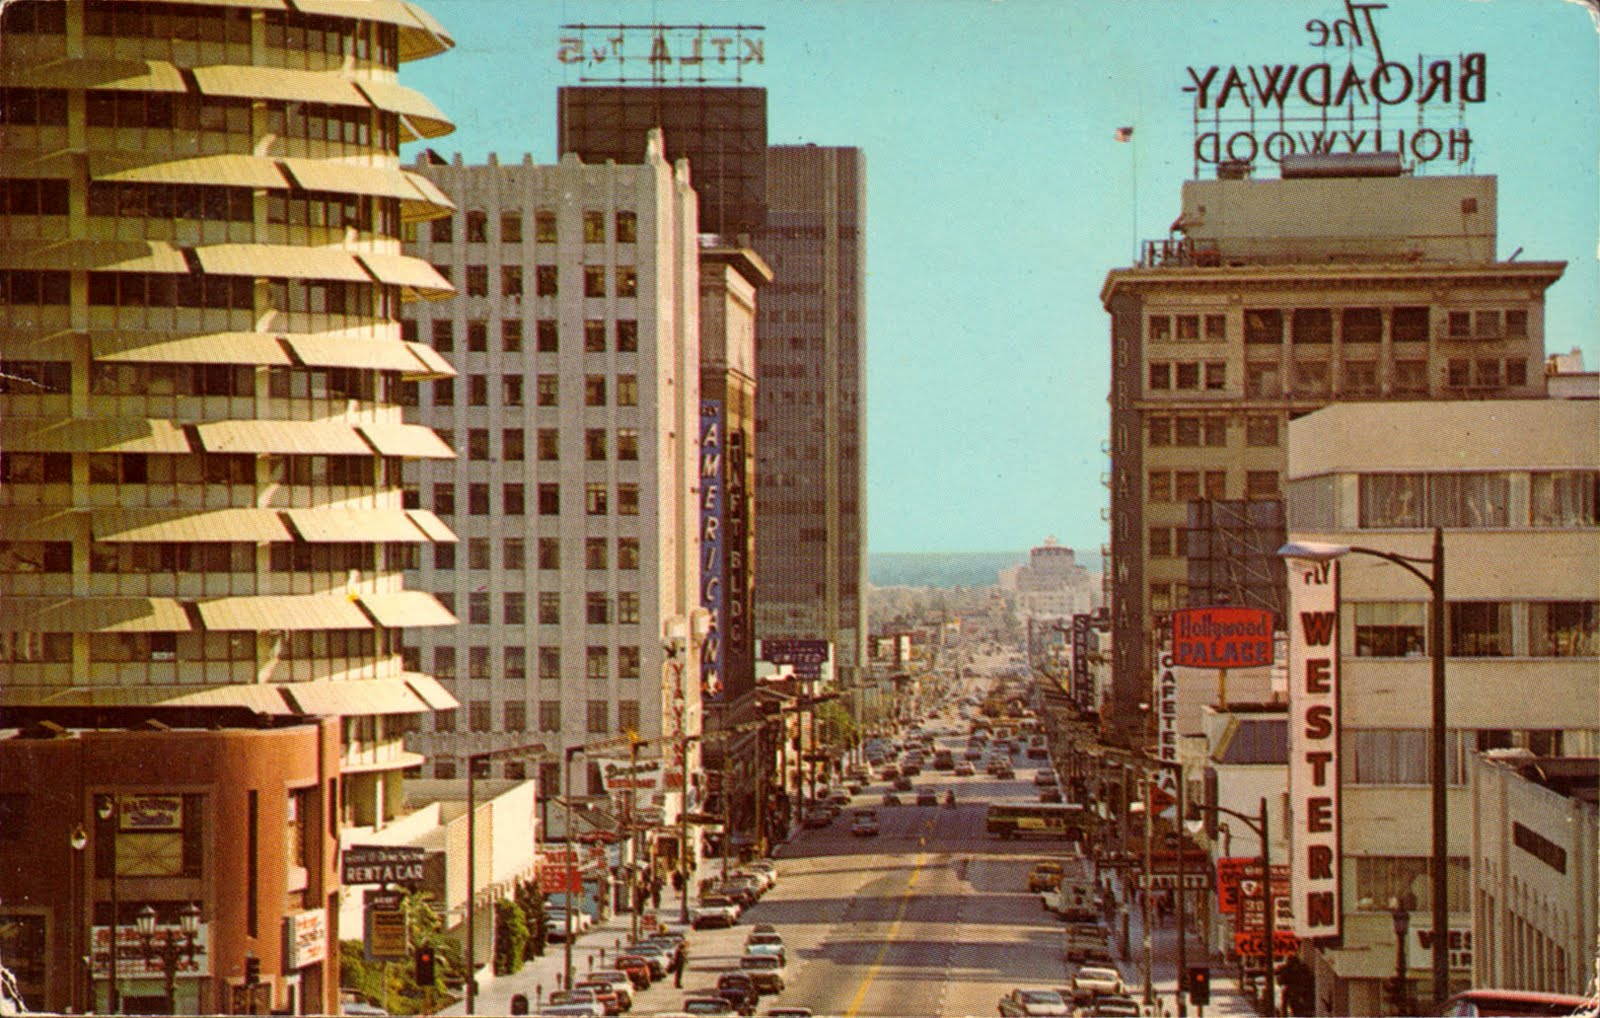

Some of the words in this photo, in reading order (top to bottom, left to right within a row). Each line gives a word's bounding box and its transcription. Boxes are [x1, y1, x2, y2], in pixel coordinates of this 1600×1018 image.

[703, 422, 721, 663] AMERICAN
[1179, 613, 1268, 641] Hollywood
[1180, 641, 1269, 663] PALACE
[1301, 611, 1336, 928] WESTERN
[345, 866, 381, 881] RENT
[383, 865, 394, 881] A
[396, 864, 424, 880] CAR
